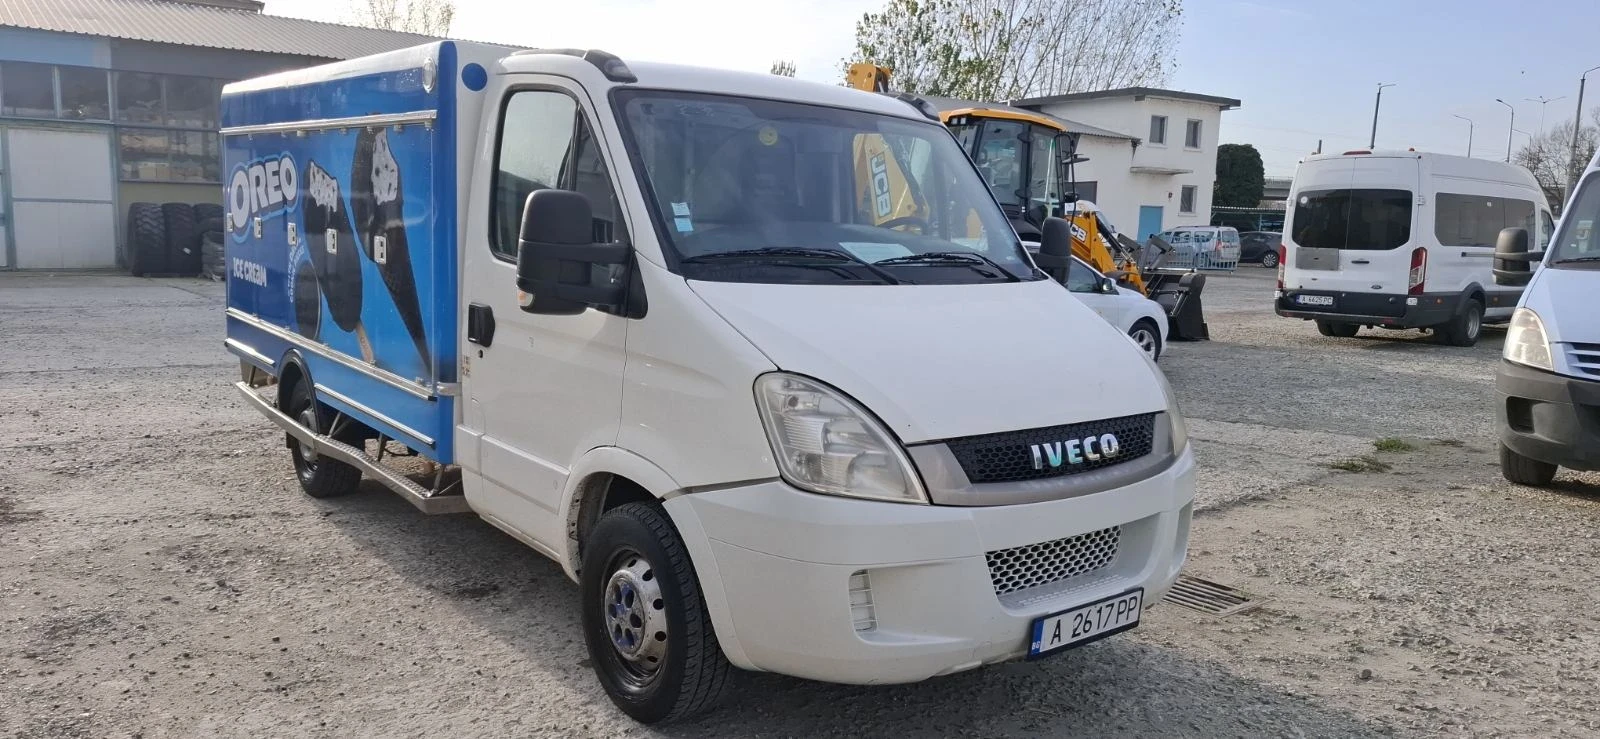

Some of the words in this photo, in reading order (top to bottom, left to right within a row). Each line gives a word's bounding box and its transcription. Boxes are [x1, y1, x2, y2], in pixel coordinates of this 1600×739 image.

[230, 157, 298, 229] OREO
[871, 155, 892, 217] JCB
[1069, 221, 1087, 242] CB
[232, 256, 244, 280] ICE
[1030, 432, 1120, 471] IVECO
[1050, 619, 1062, 646] A
